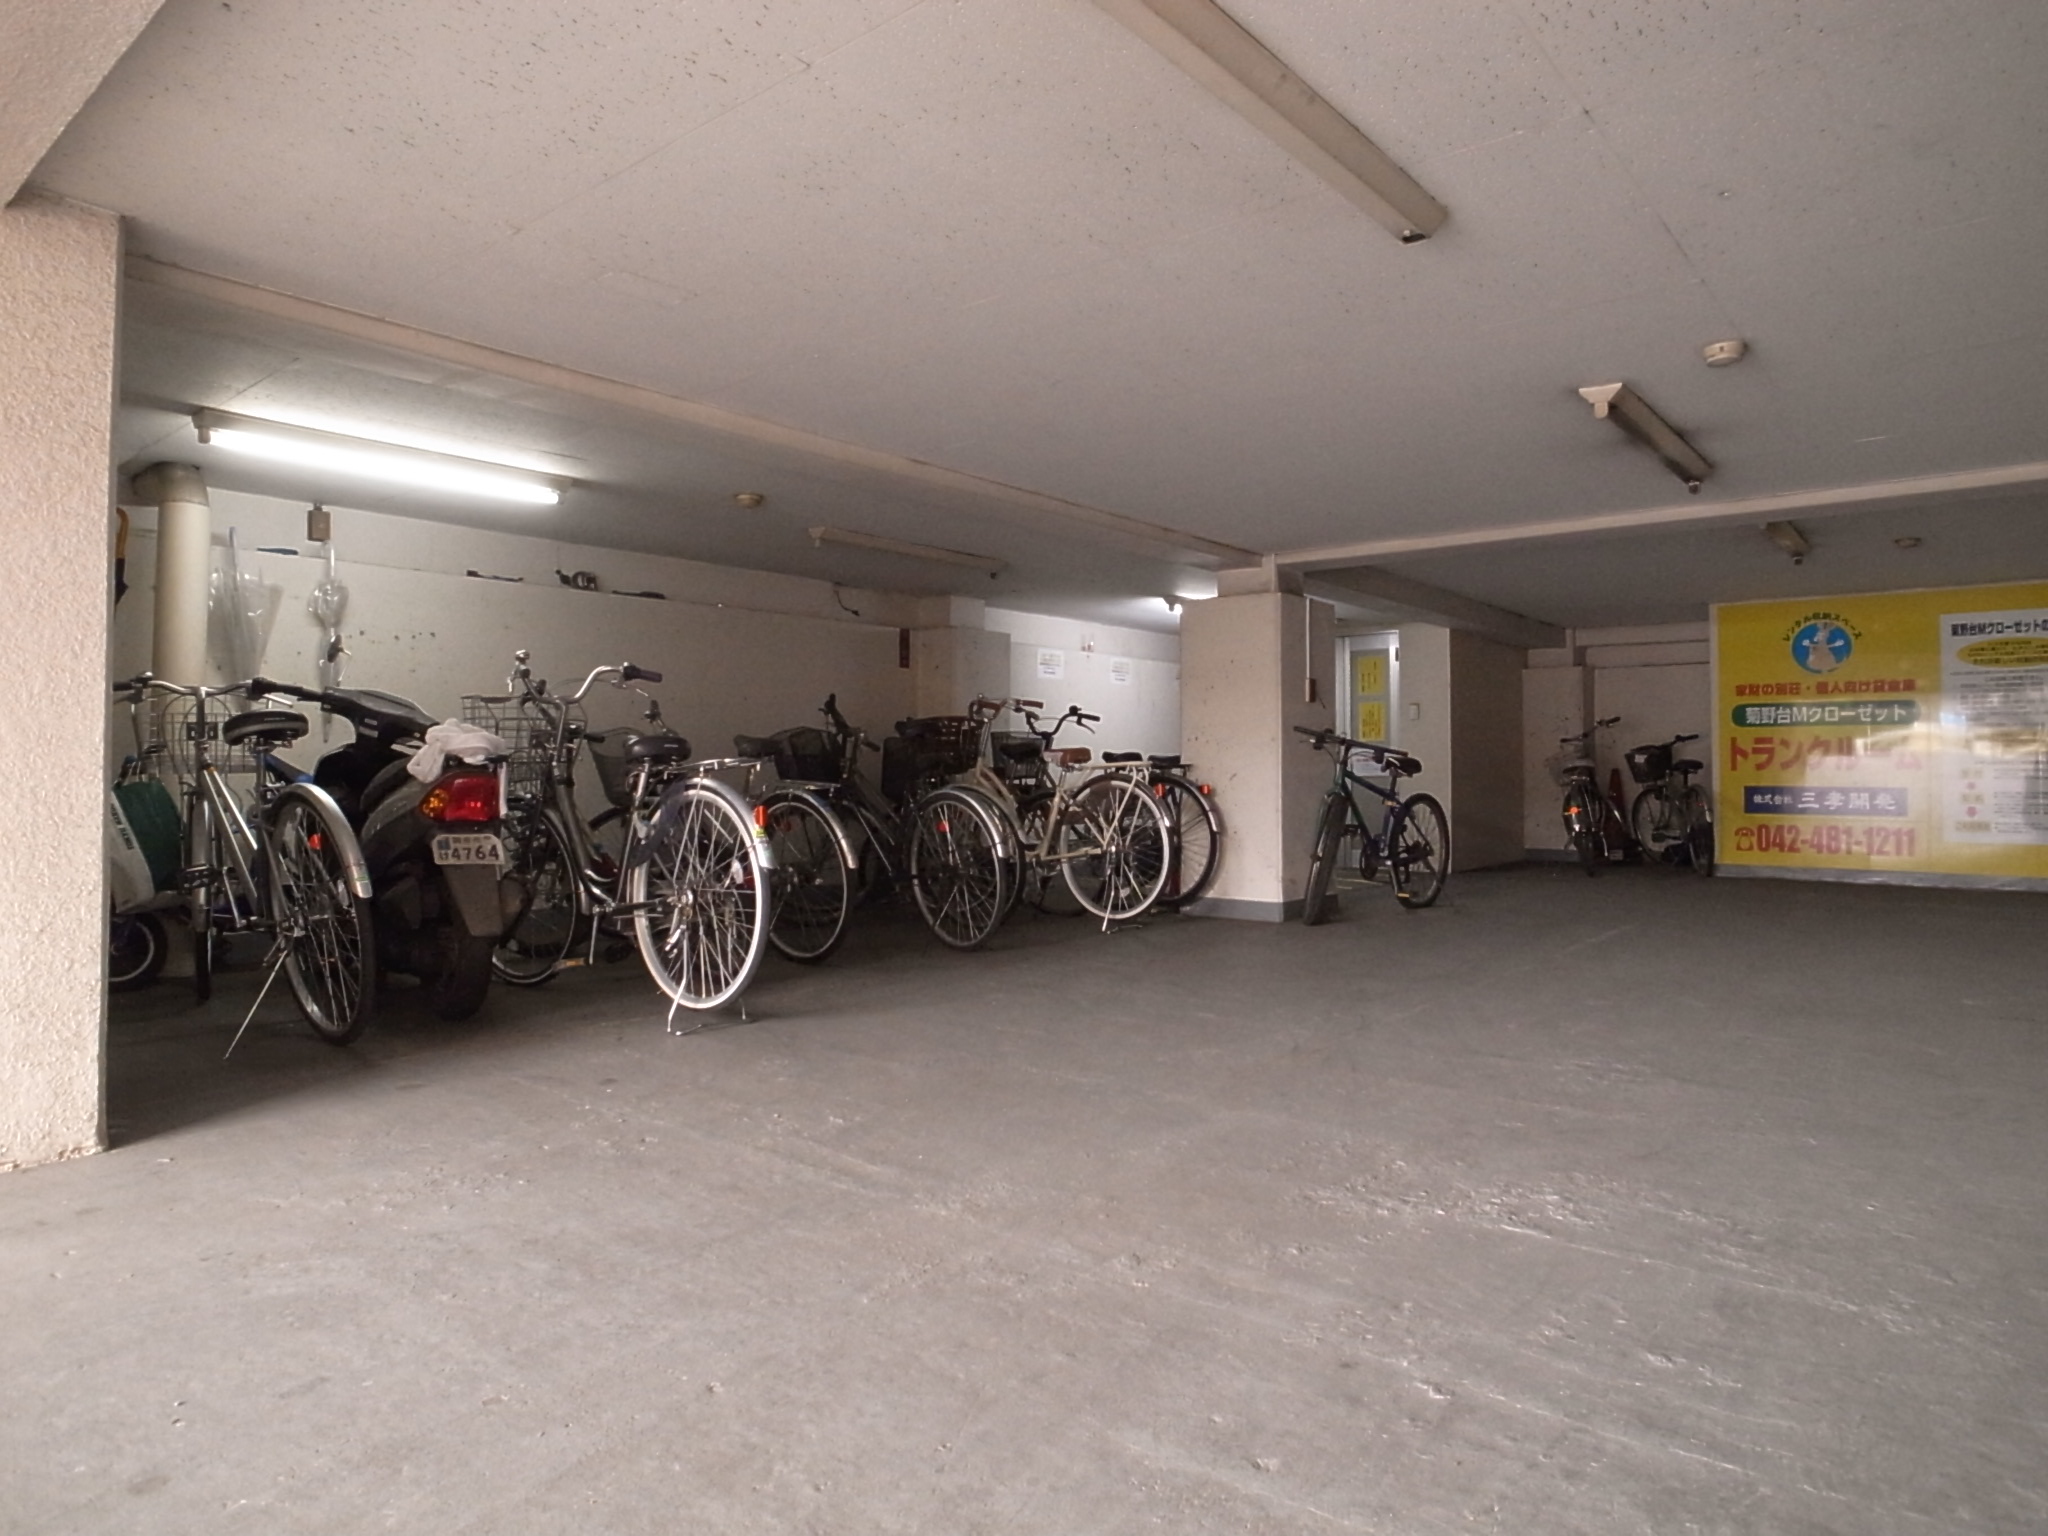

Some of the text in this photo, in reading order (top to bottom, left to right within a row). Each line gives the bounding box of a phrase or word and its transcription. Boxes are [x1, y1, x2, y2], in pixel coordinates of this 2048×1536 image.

[1745, 704, 1906, 724] 菊野台Mクローゼット
[1756, 824, 1916, 857] 042-481-1211
[451, 844, 499, 861] 4764
